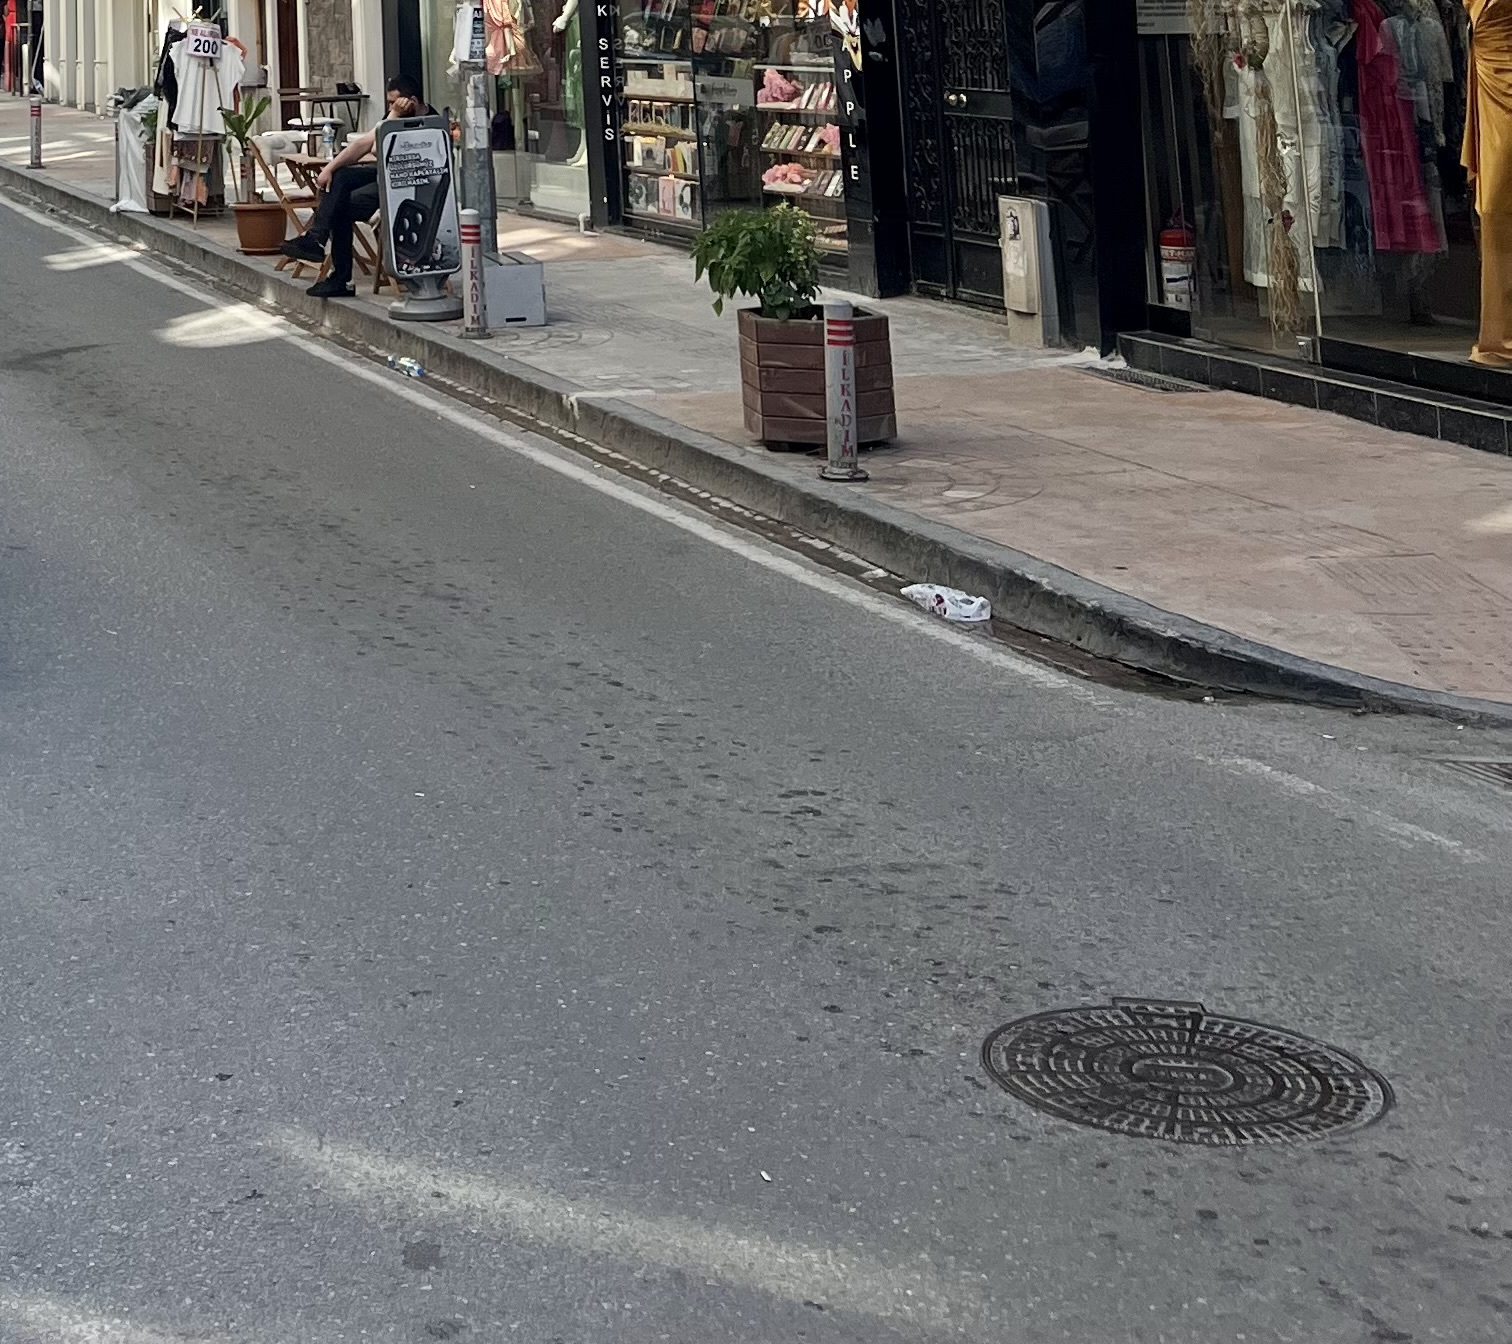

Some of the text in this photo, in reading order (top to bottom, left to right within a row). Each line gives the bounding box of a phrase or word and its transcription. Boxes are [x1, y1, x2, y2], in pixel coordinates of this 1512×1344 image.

[193, 38, 219, 55] 200
[598, 37, 616, 142] SERVİS
[841, 37, 860, 182] APPLE
